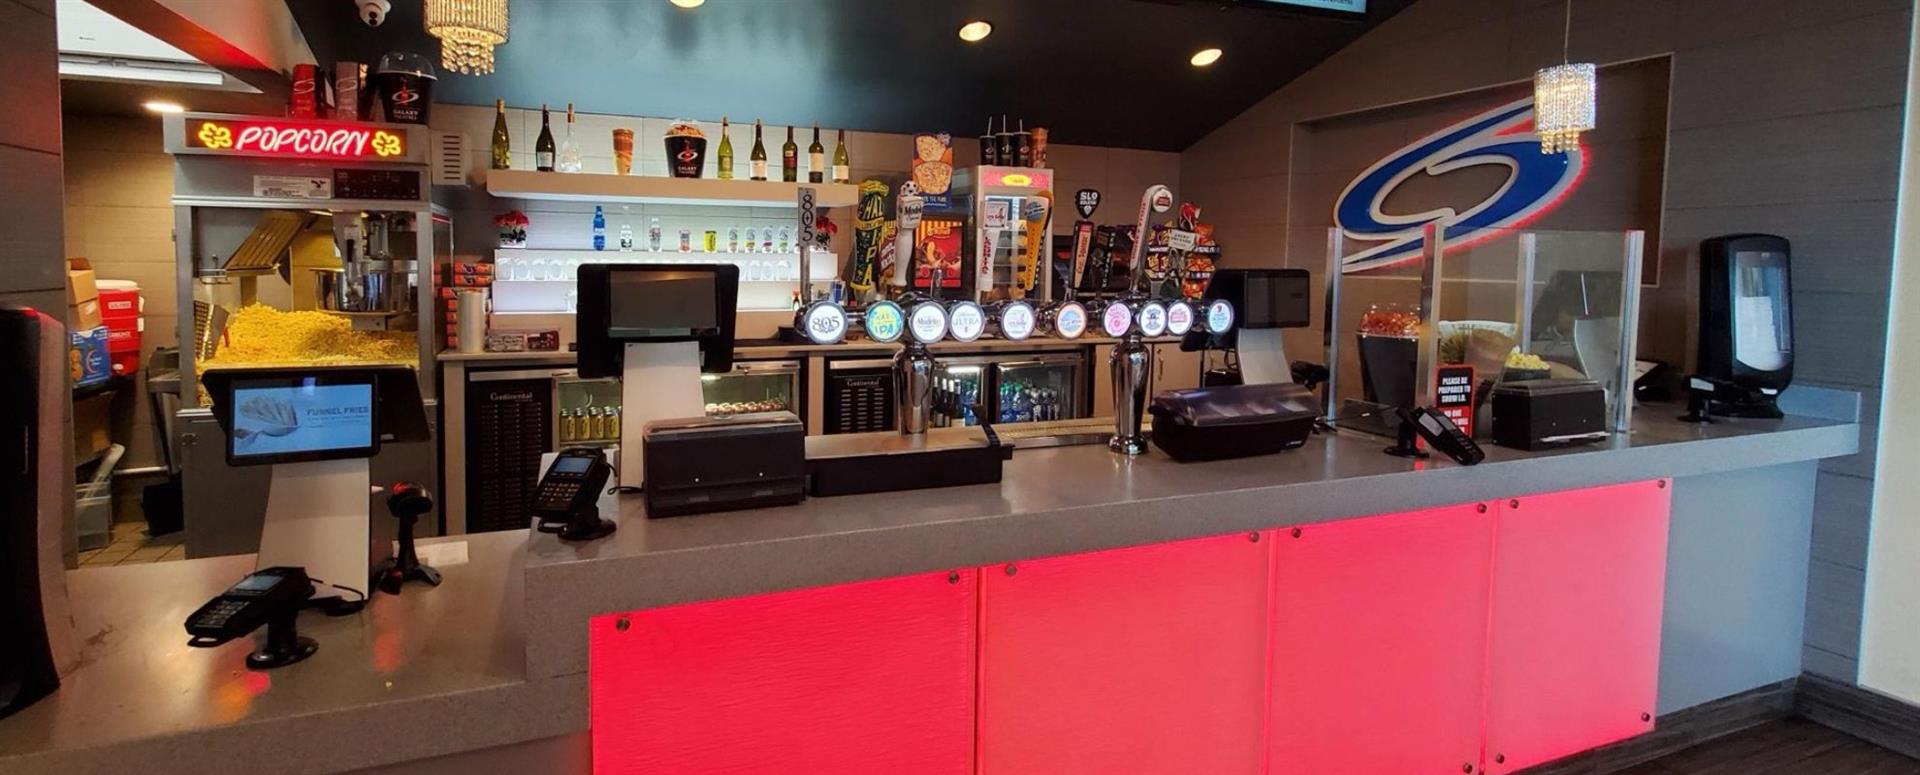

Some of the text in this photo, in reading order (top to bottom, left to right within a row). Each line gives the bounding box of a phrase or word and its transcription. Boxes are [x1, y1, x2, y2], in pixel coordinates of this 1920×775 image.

[235, 126, 370, 155] POPCORN
[1080, 191, 1098, 200] SLO
[802, 193, 814, 242] 805
[812, 316, 841, 331] 805
[1442, 376, 1468, 385] PLEASE BE
[1438, 385, 1471, 394] PREPARED TO
[490, 391, 533, 402] Continental
[1441, 395, 1457, 403] SHOW
[306, 406, 369, 416] FUNNEL FRIES
